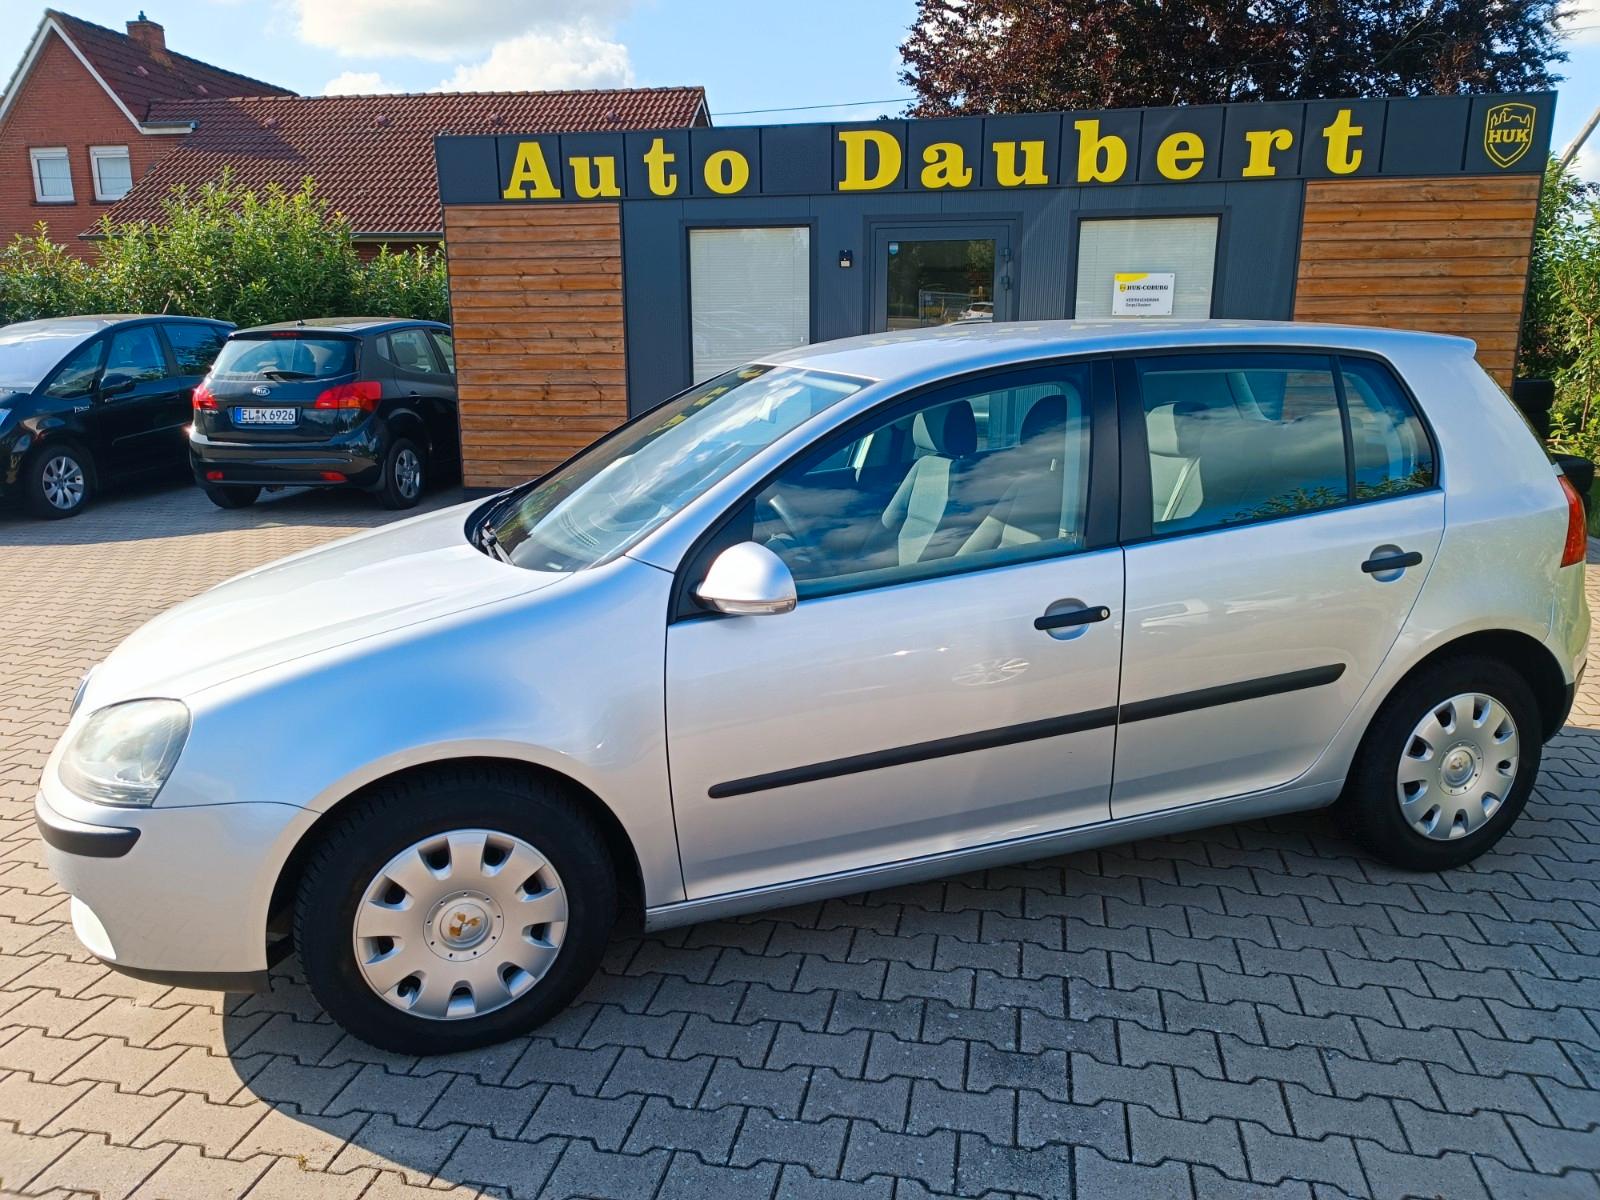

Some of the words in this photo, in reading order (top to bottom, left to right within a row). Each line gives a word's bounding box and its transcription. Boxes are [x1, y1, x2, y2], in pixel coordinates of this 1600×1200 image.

[1488, 129, 1530, 143] HUK
[503, 138, 749, 199] Auto
[838, 109, 1363, 191] Daubert
[242, 409, 255, 420] EL
[269, 409, 294, 421] 6926
